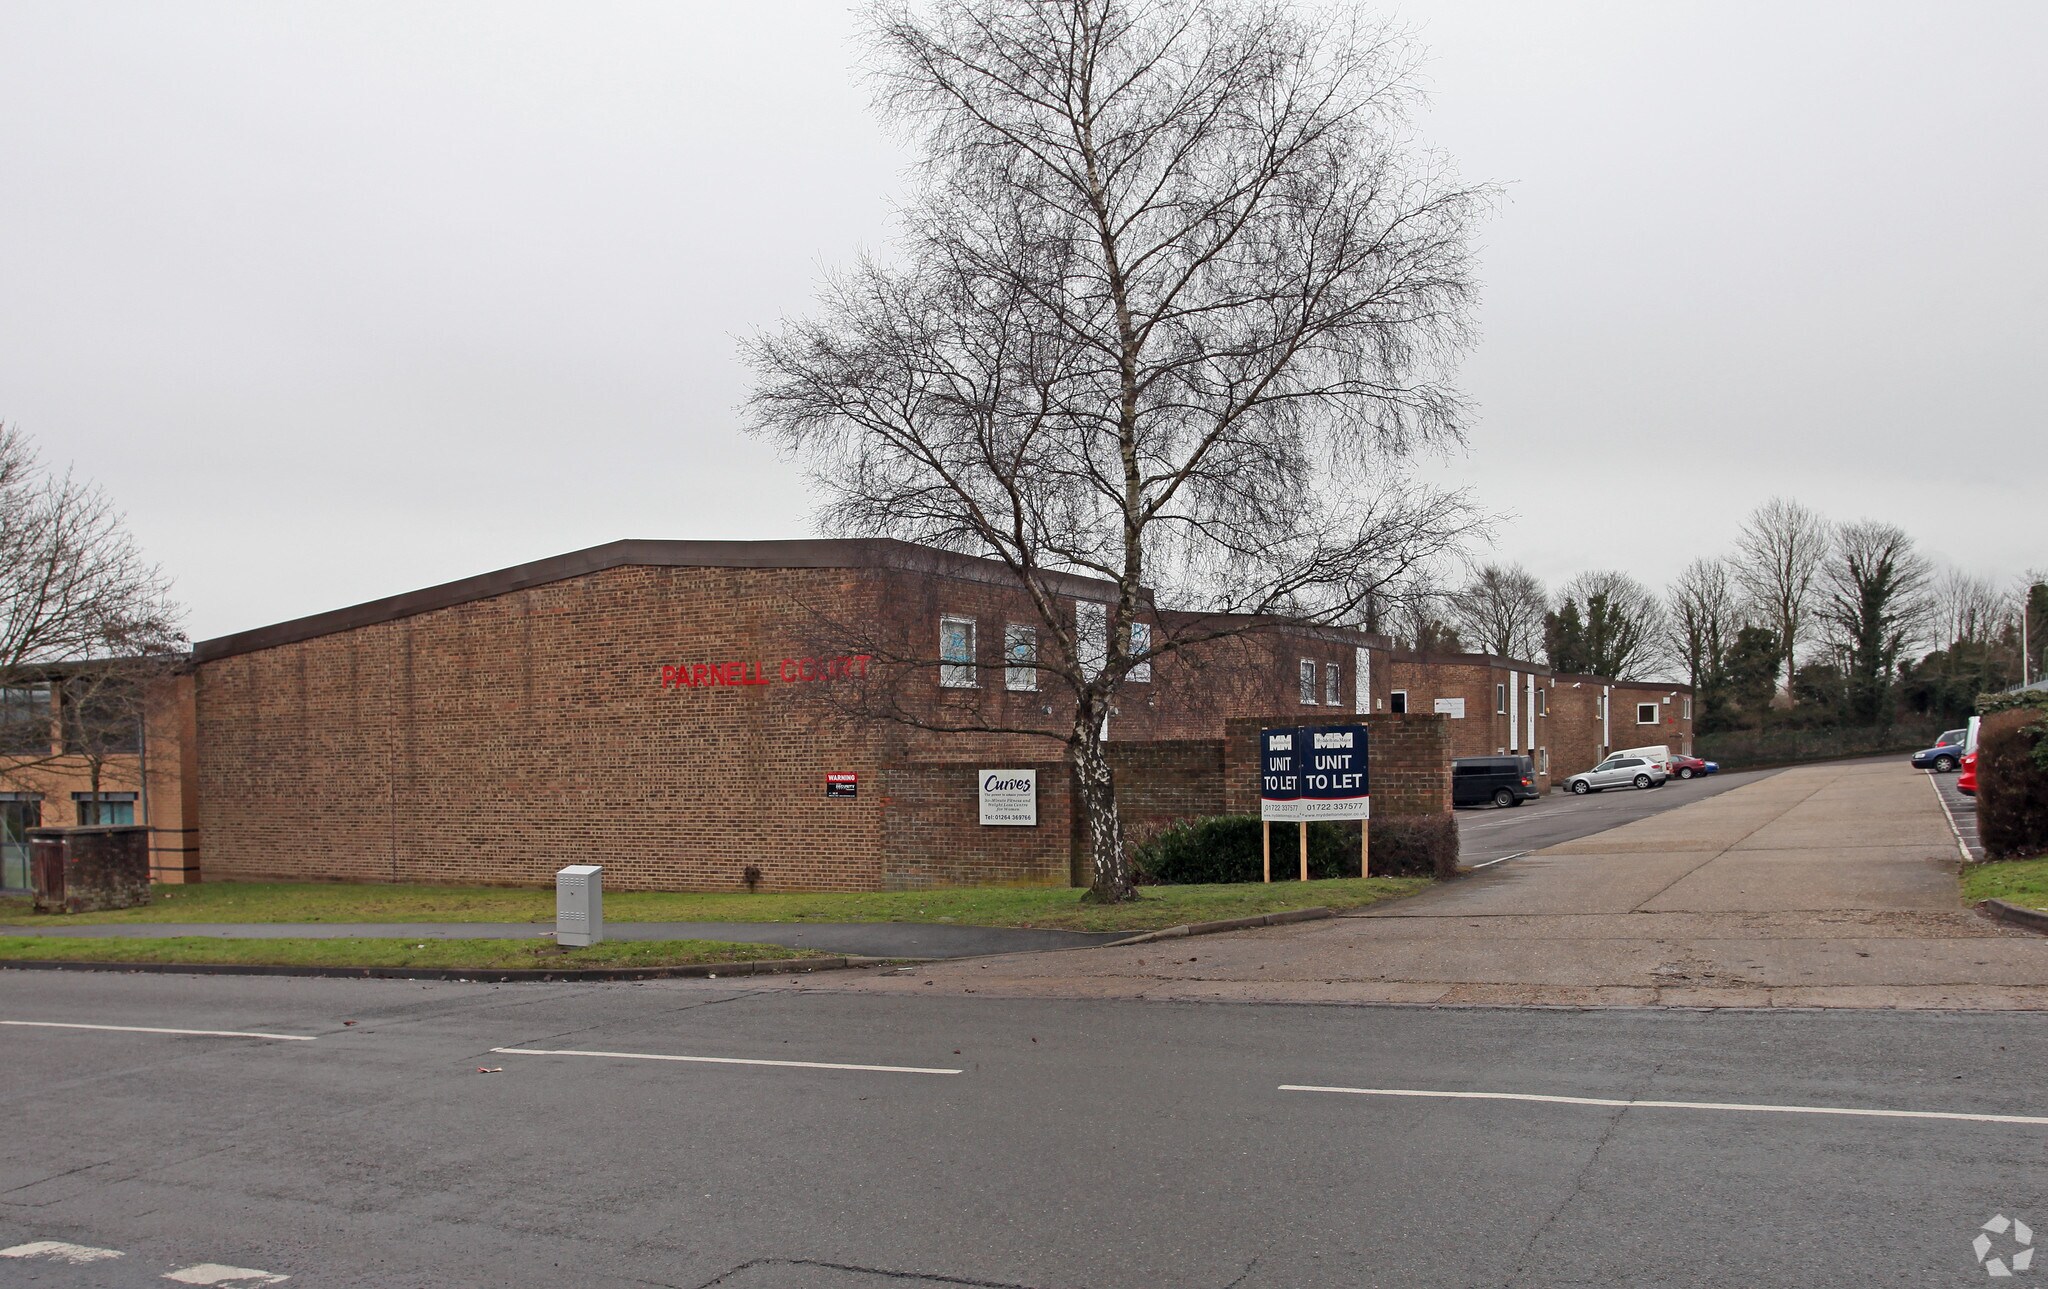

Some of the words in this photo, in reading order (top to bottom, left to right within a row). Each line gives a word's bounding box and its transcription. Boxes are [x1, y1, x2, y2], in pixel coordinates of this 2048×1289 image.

[662, 661, 769, 688] PARNELL
[780, 654, 872, 682] COURT
[1269, 757, 1291, 771] UNIT
[1315, 755, 1352, 770] UNIT
[984, 775, 1031, 792] Curves
[1264, 776, 1278, 790] TO
[1280, 776, 1297, 790] LET
[1306, 775, 1328, 789] TO
[1333, 774, 1363, 788] LET
